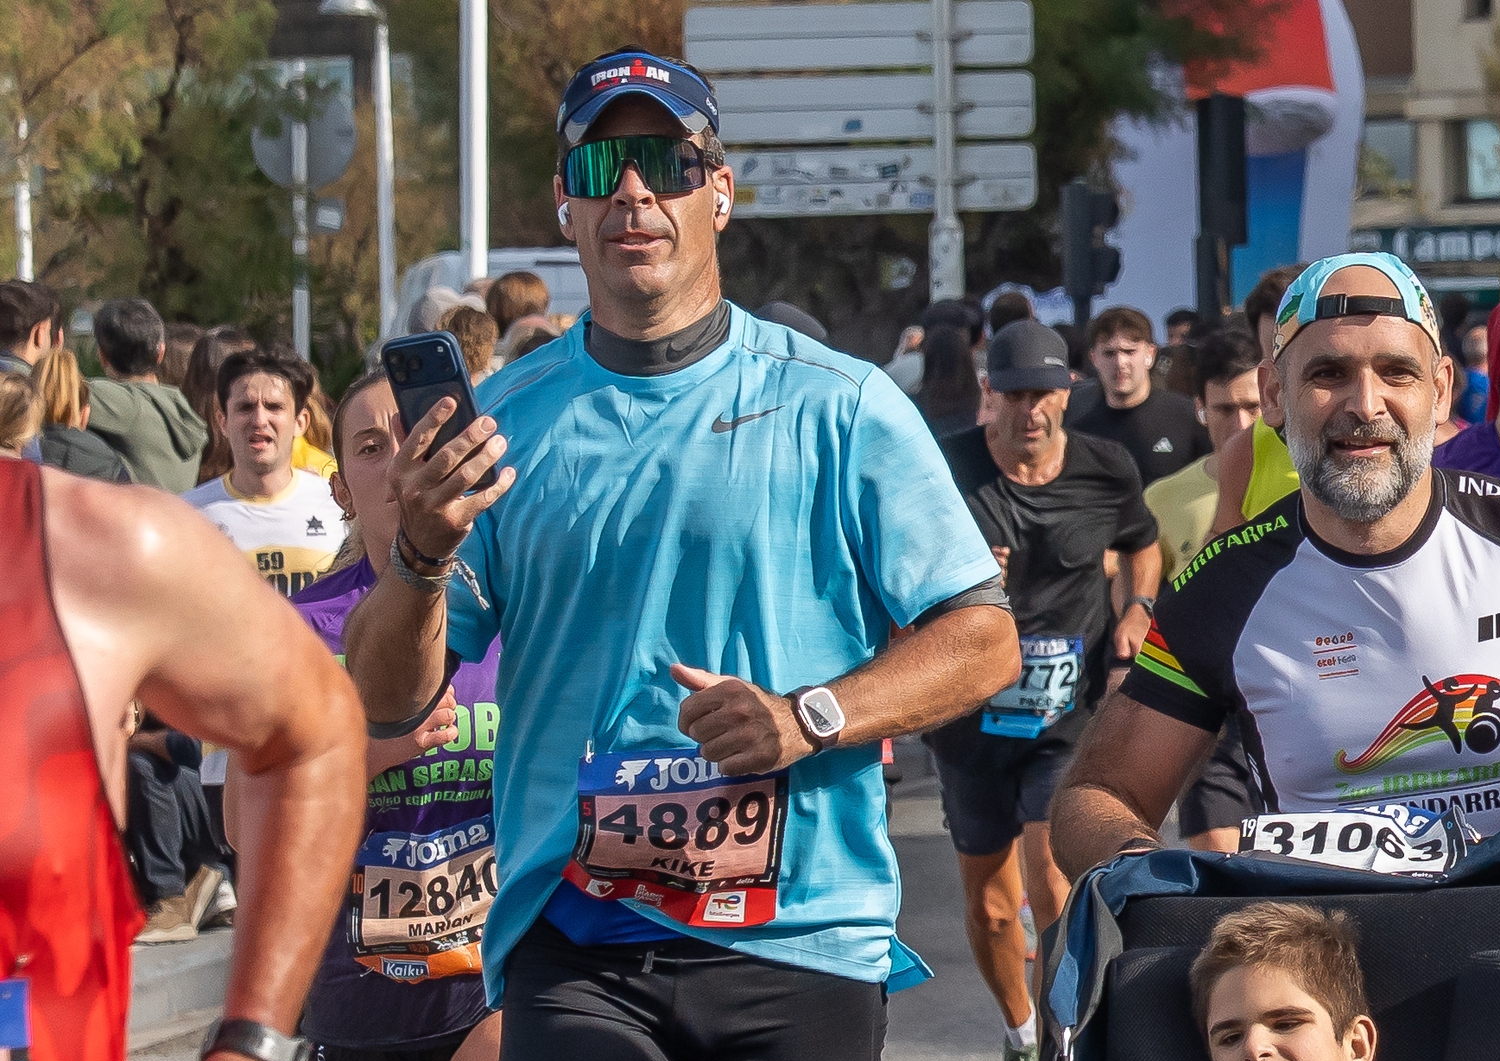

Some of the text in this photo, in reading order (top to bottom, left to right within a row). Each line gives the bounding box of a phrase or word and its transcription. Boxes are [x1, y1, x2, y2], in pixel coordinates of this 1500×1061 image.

[591, 59, 671, 86] IRONMAN
[256, 551, 284, 571] 59
[1172, 515, 1290, 593] IRRIFARRA
[412, 758, 493, 788] SEBAS
[650, 757, 726, 790] Jom
[405, 793, 432, 806] EGIN
[434, 788, 485, 802] DEZAGUN
[582, 801, 591, 817] 5
[598, 791, 770, 851] 4889
[1241, 818, 1257, 838] 19
[405, 824, 489, 868] Joma
[1262, 821, 1444, 862] 31063
[650, 857, 716, 877] KIKE
[352, 873, 364, 894] 10
[408, 913, 474, 937] MARION
[386, 962, 424, 977] Kaiku
